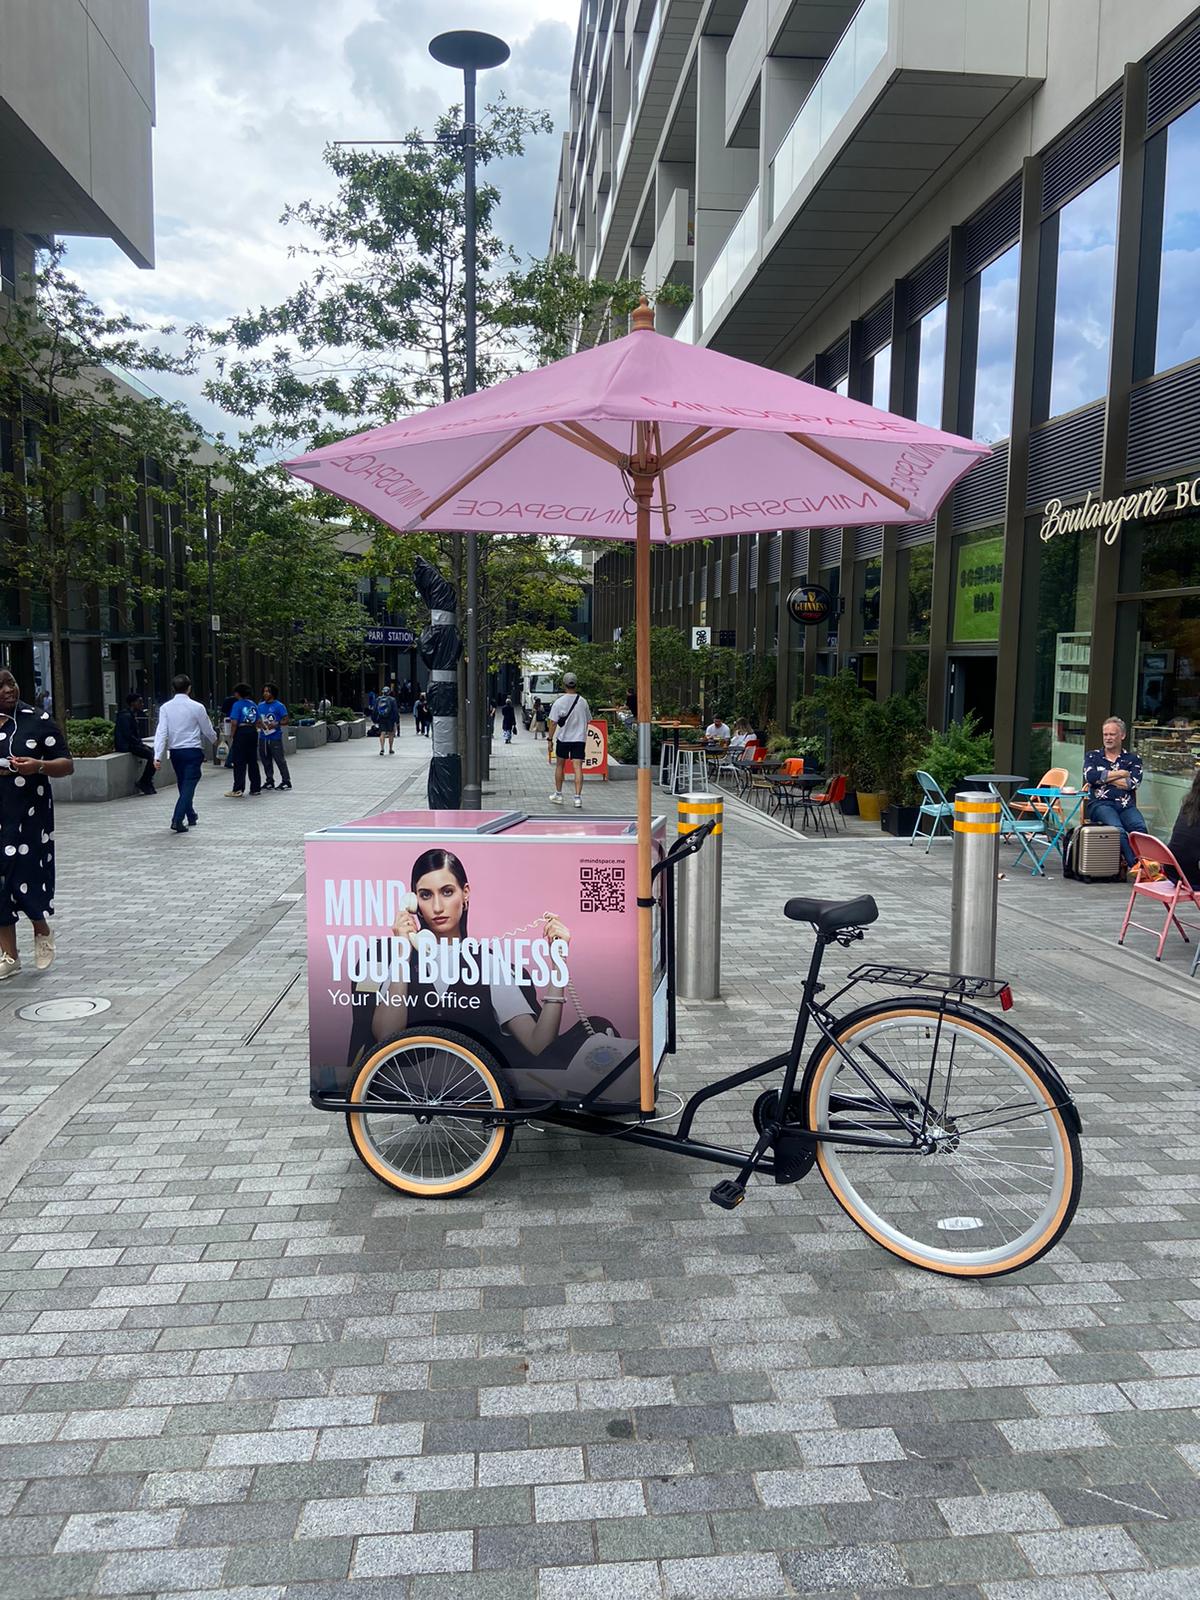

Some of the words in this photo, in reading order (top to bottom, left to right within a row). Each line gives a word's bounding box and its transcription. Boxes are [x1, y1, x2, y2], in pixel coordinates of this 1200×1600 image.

[1039, 486, 1168, 546] Boulangerie
[387, 631, 415, 642] STATION
[324, 879, 407, 928] MIND
[326, 934, 413, 984] YOUR
[416, 936, 570, 989] BUSINESS
[327, 988, 370, 1007] Your
[375, 989, 419, 1008] New
[424, 990, 481, 1010] Office
